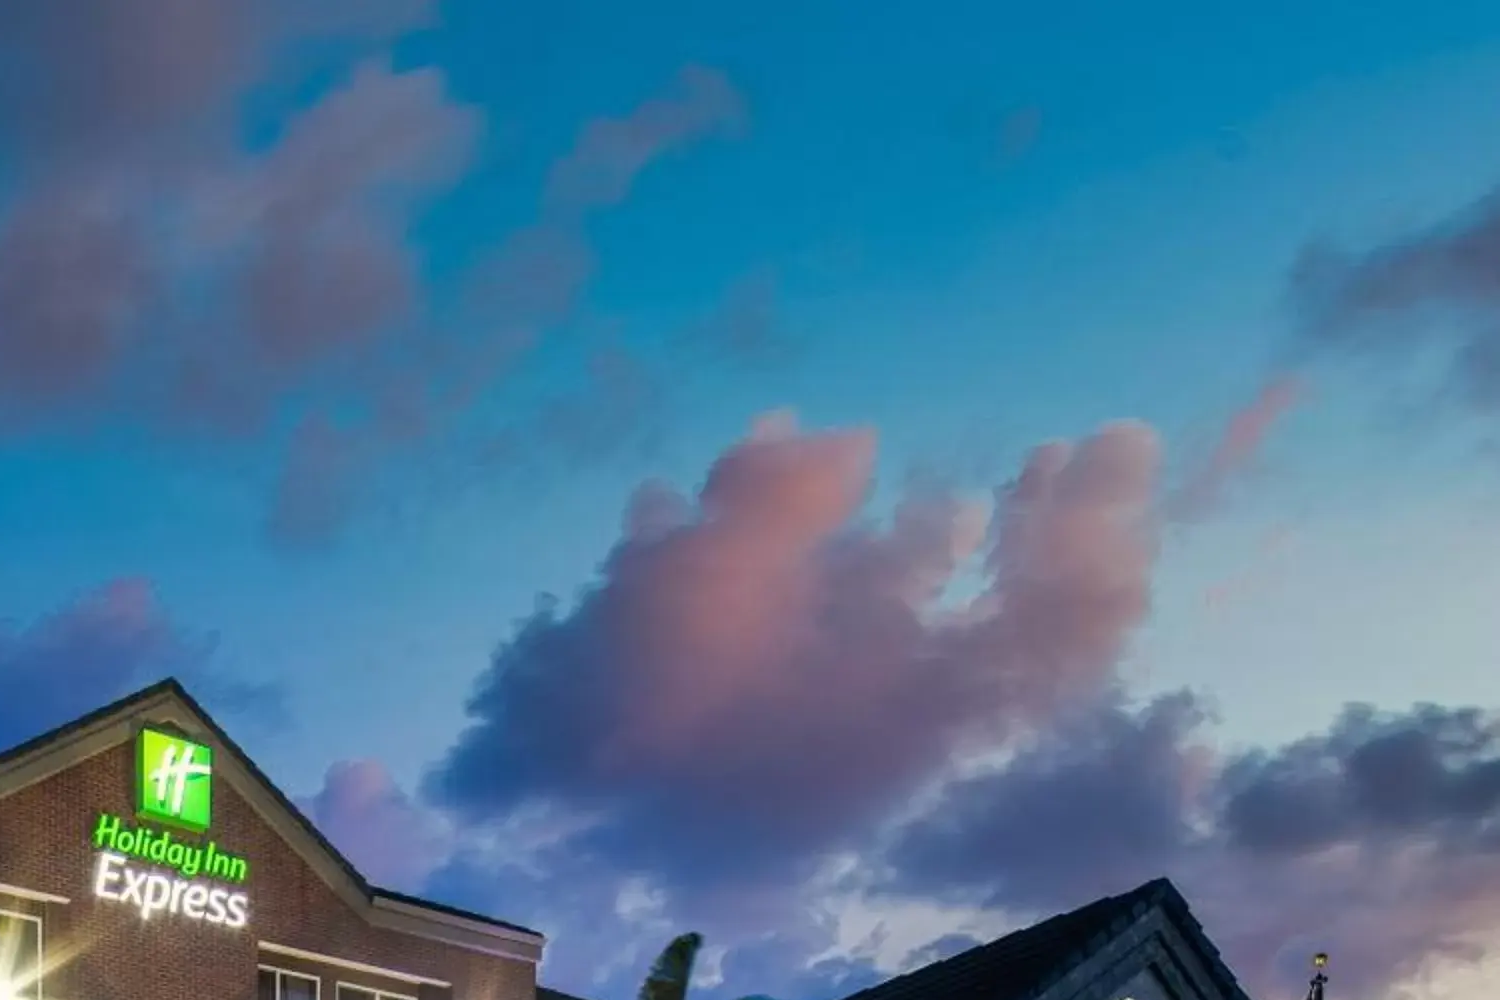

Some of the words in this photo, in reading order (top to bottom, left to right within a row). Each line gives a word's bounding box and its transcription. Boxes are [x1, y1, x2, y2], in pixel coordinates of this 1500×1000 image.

[94, 814, 201, 875] Holiday
[206, 842, 246, 881] Inn
[95, 852, 248, 927] Express
